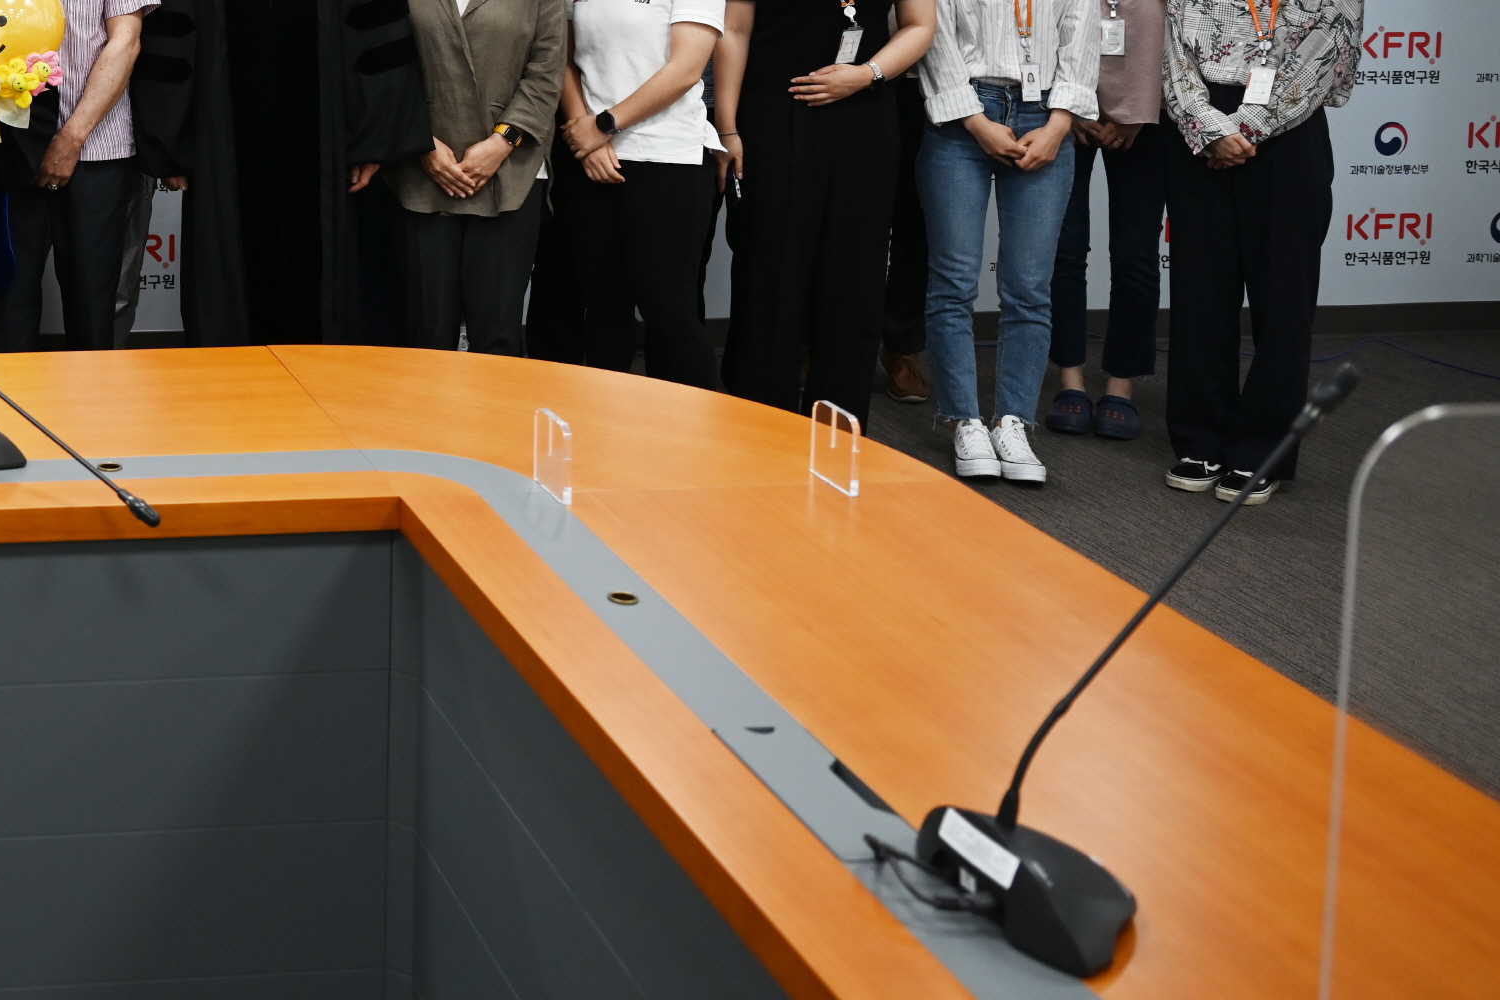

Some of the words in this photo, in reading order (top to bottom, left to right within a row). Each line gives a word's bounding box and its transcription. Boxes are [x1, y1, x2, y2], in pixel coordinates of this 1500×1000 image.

[1350, 165, 1428, 175] 과학기술정보통신부
[1347, 212, 1432, 241] KFRI
[1345, 251, 1430, 266] 한국식품연구원
